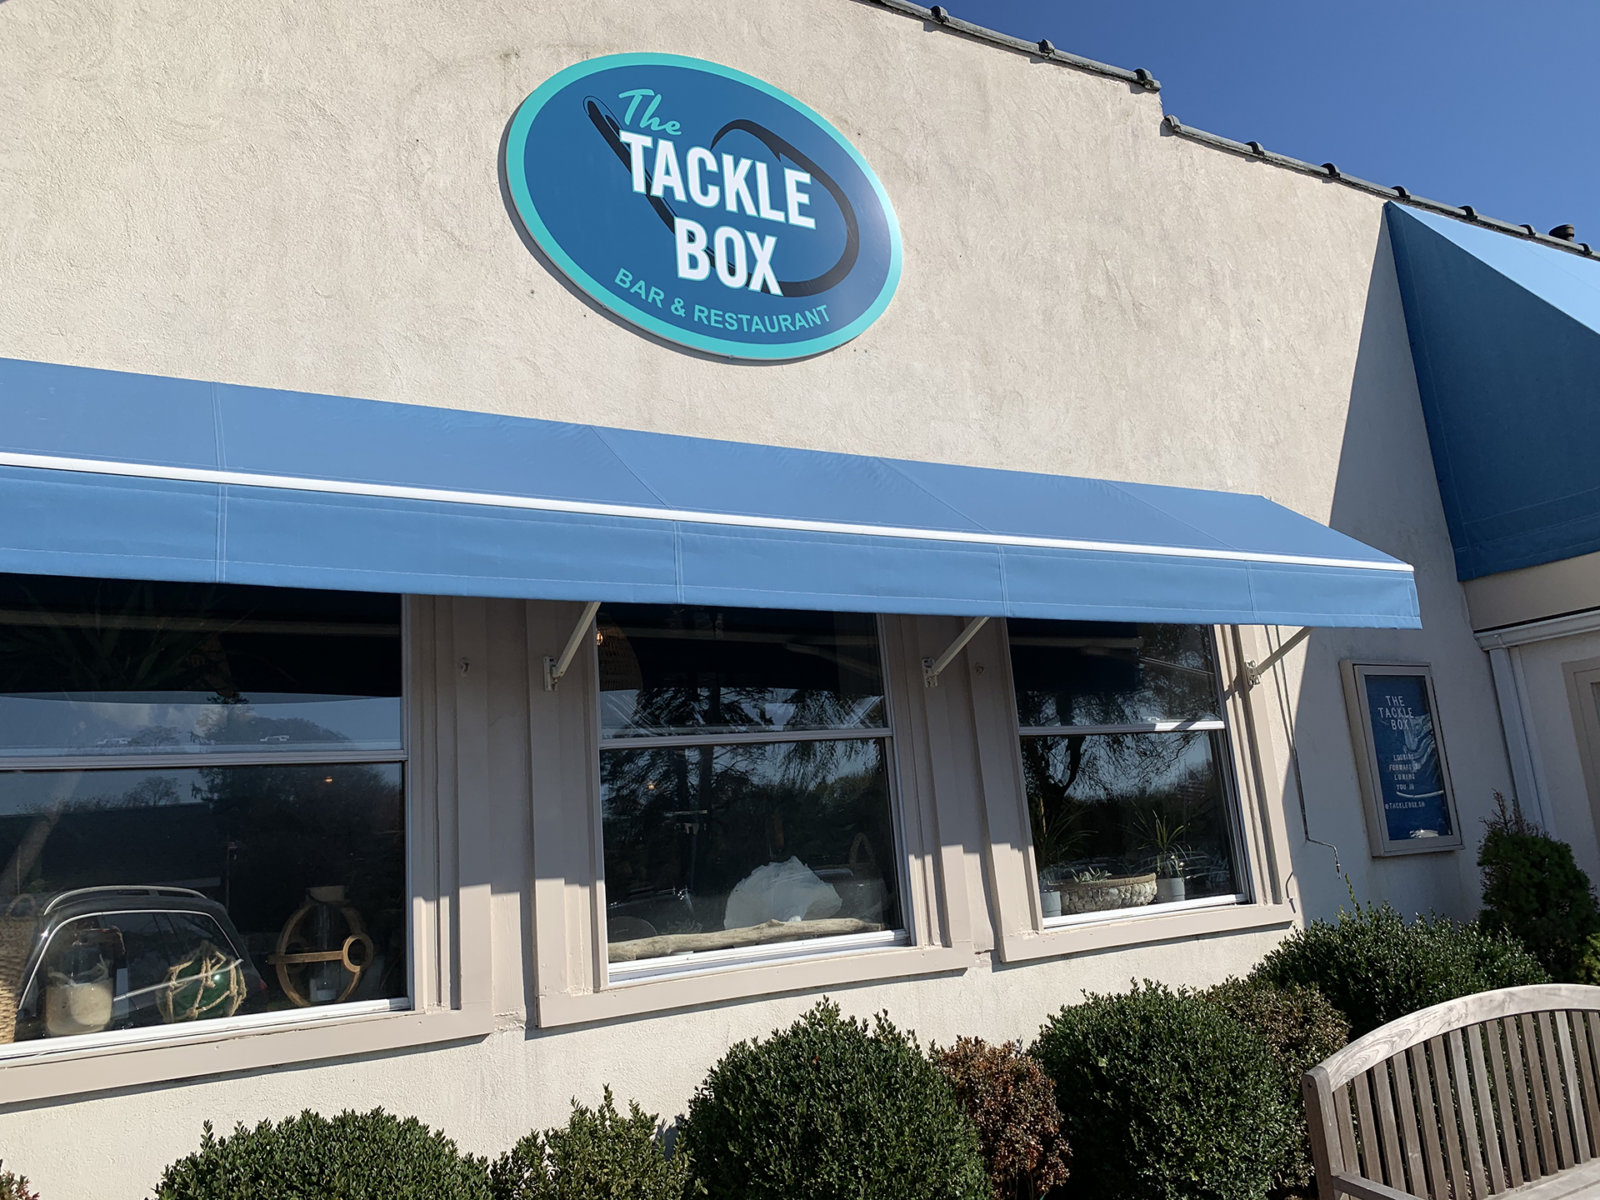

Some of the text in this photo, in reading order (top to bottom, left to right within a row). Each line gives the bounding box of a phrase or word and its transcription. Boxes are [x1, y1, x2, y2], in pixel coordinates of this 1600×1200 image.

[618, 88, 682, 136] The
[619, 129, 817, 230] TACKLE
[674, 216, 784, 297] BOX
[614, 267, 831, 334] BAR & RESTAURANT
[1377, 707, 1414, 718] TACKLE
[1385, 695, 1405, 706] THE
[1390, 719, 1409, 730] BOX
